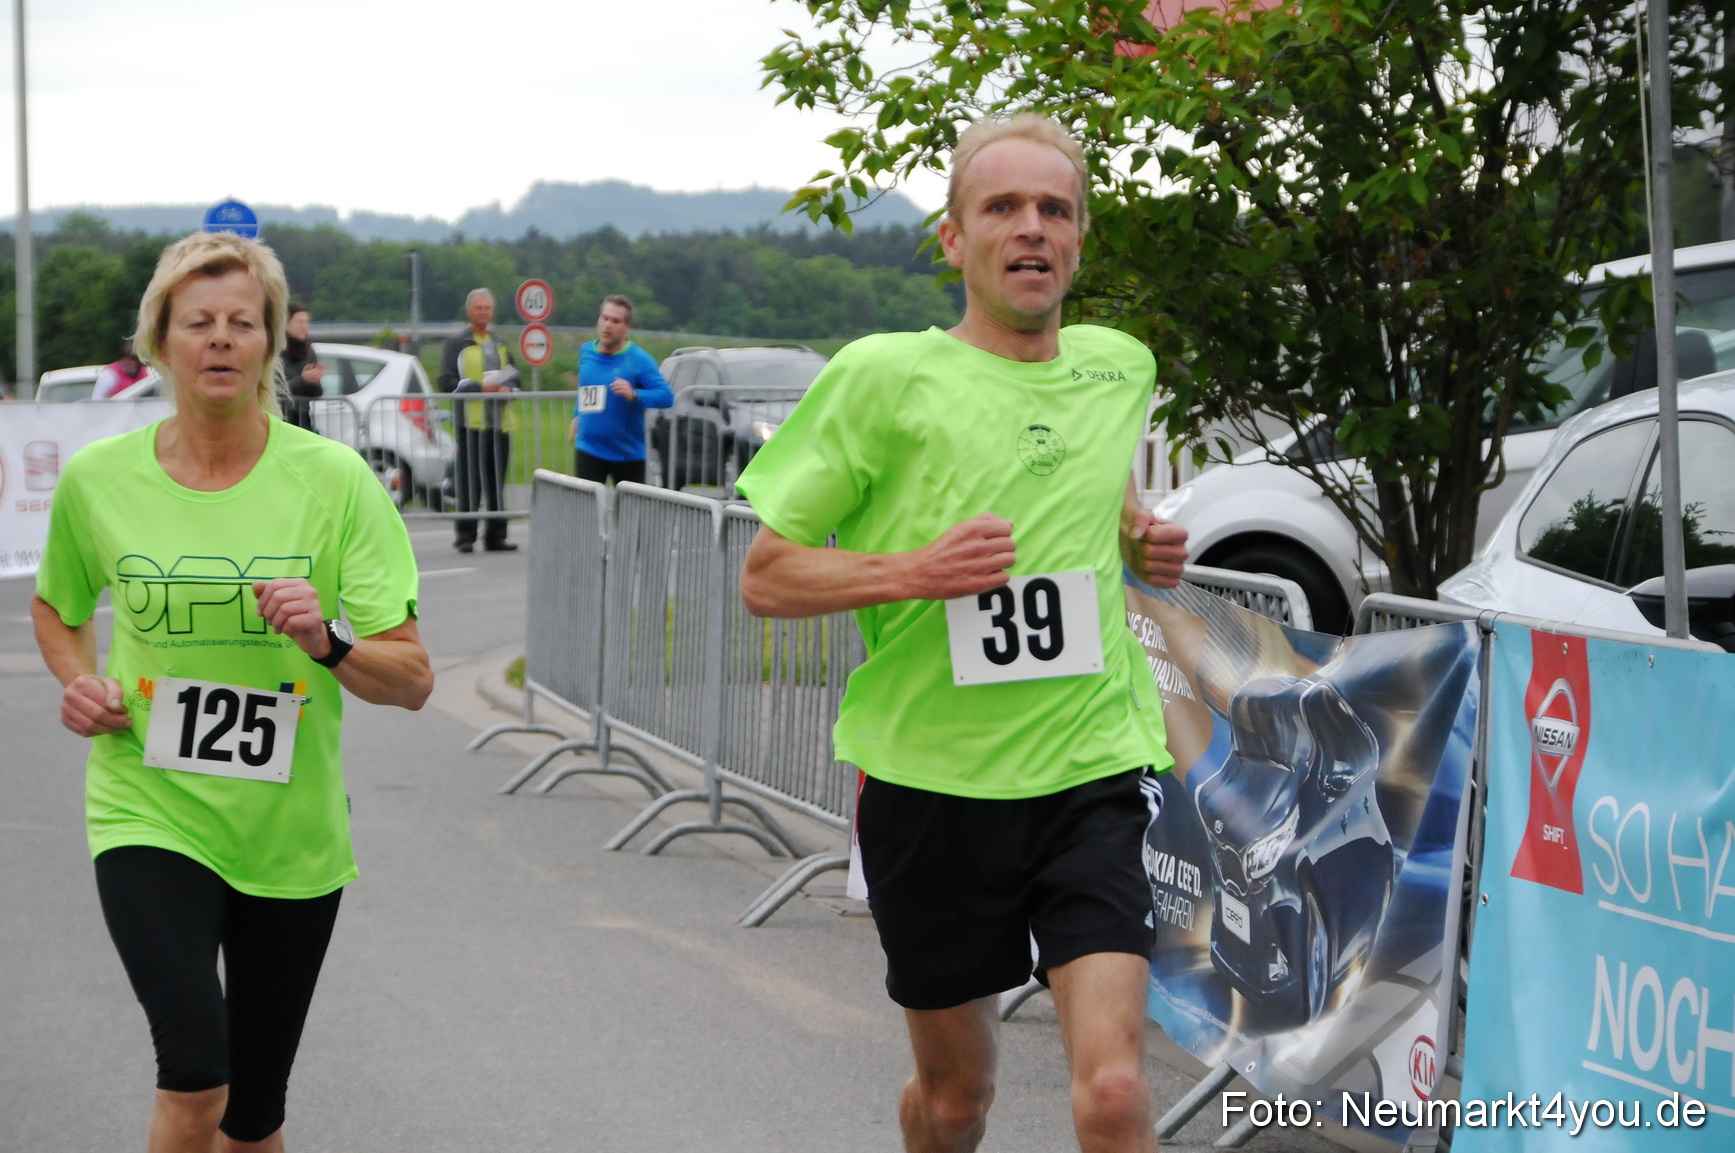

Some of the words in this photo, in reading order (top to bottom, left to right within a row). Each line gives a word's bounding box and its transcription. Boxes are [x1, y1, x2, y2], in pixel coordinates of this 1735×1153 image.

[525, 290, 544, 309] 60
[1086, 370, 1127, 382] DEKRA
[582, 387, 598, 407] 20
[978, 577, 1065, 666] 39
[170, 638, 282, 649] Automatisierungstechnik
[177, 686, 278, 767] 125
[1534, 725, 1575, 749] NISSAN
[1588, 795, 1651, 903] SO
[1587, 954, 1735, 1090] NOCH
